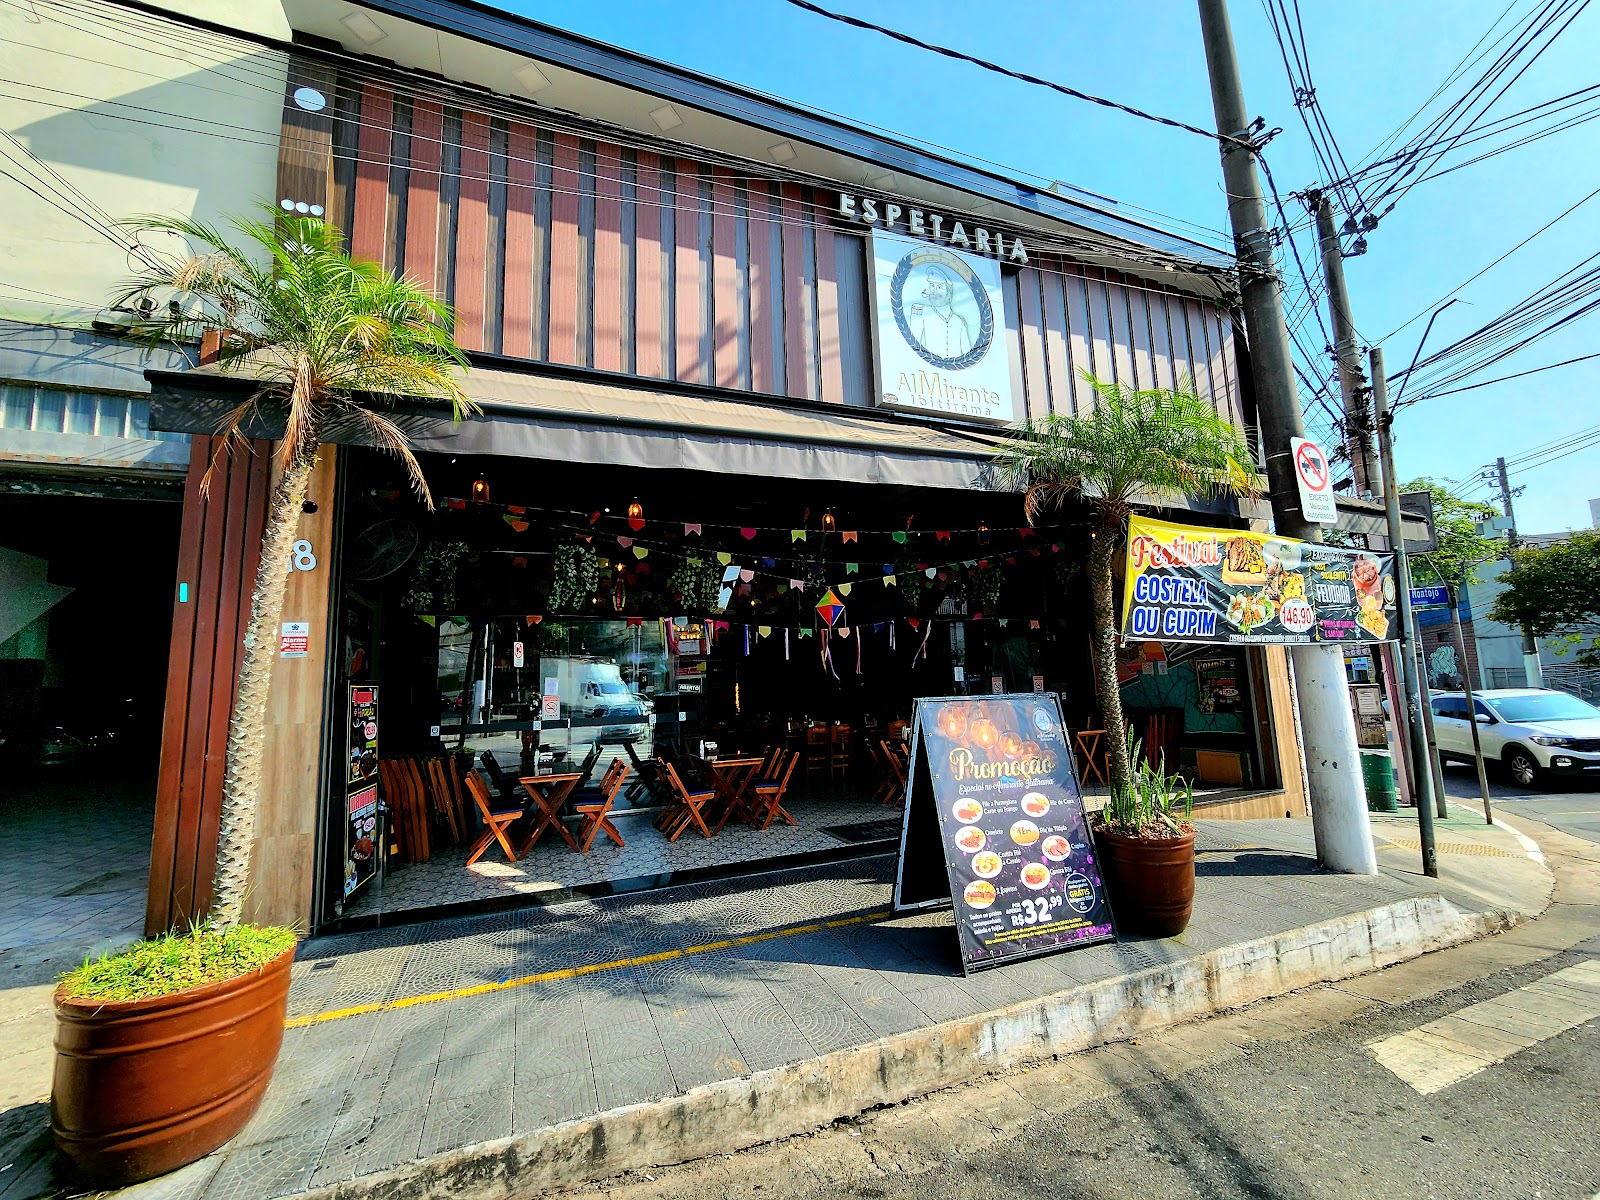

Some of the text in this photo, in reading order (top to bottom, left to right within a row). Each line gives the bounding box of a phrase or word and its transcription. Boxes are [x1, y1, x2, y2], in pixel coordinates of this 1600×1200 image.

[840, 193, 1028, 263] ESPETARIA
[898, 370, 1000, 406] AlMirante
[911, 395, 991, 416] Ibitirama
[1309, 493, 1329, 502] EXCETO
[1131, 535, 1221, 568] Festival
[1135, 574, 1209, 605] COSTELA
[1316, 584, 1351, 604] FEIJOADA
[1412, 588, 1439, 600] Montojo
[1132, 606, 1216, 636] OU CUPIM
[1282, 606, 1312, 629] 146,90
[949, 747, 1055, 780] Promoção
[959, 781, 984, 795] Especial
[1011, 913, 1025, 926] R$
[1021, 895, 1063, 924] 32,99
